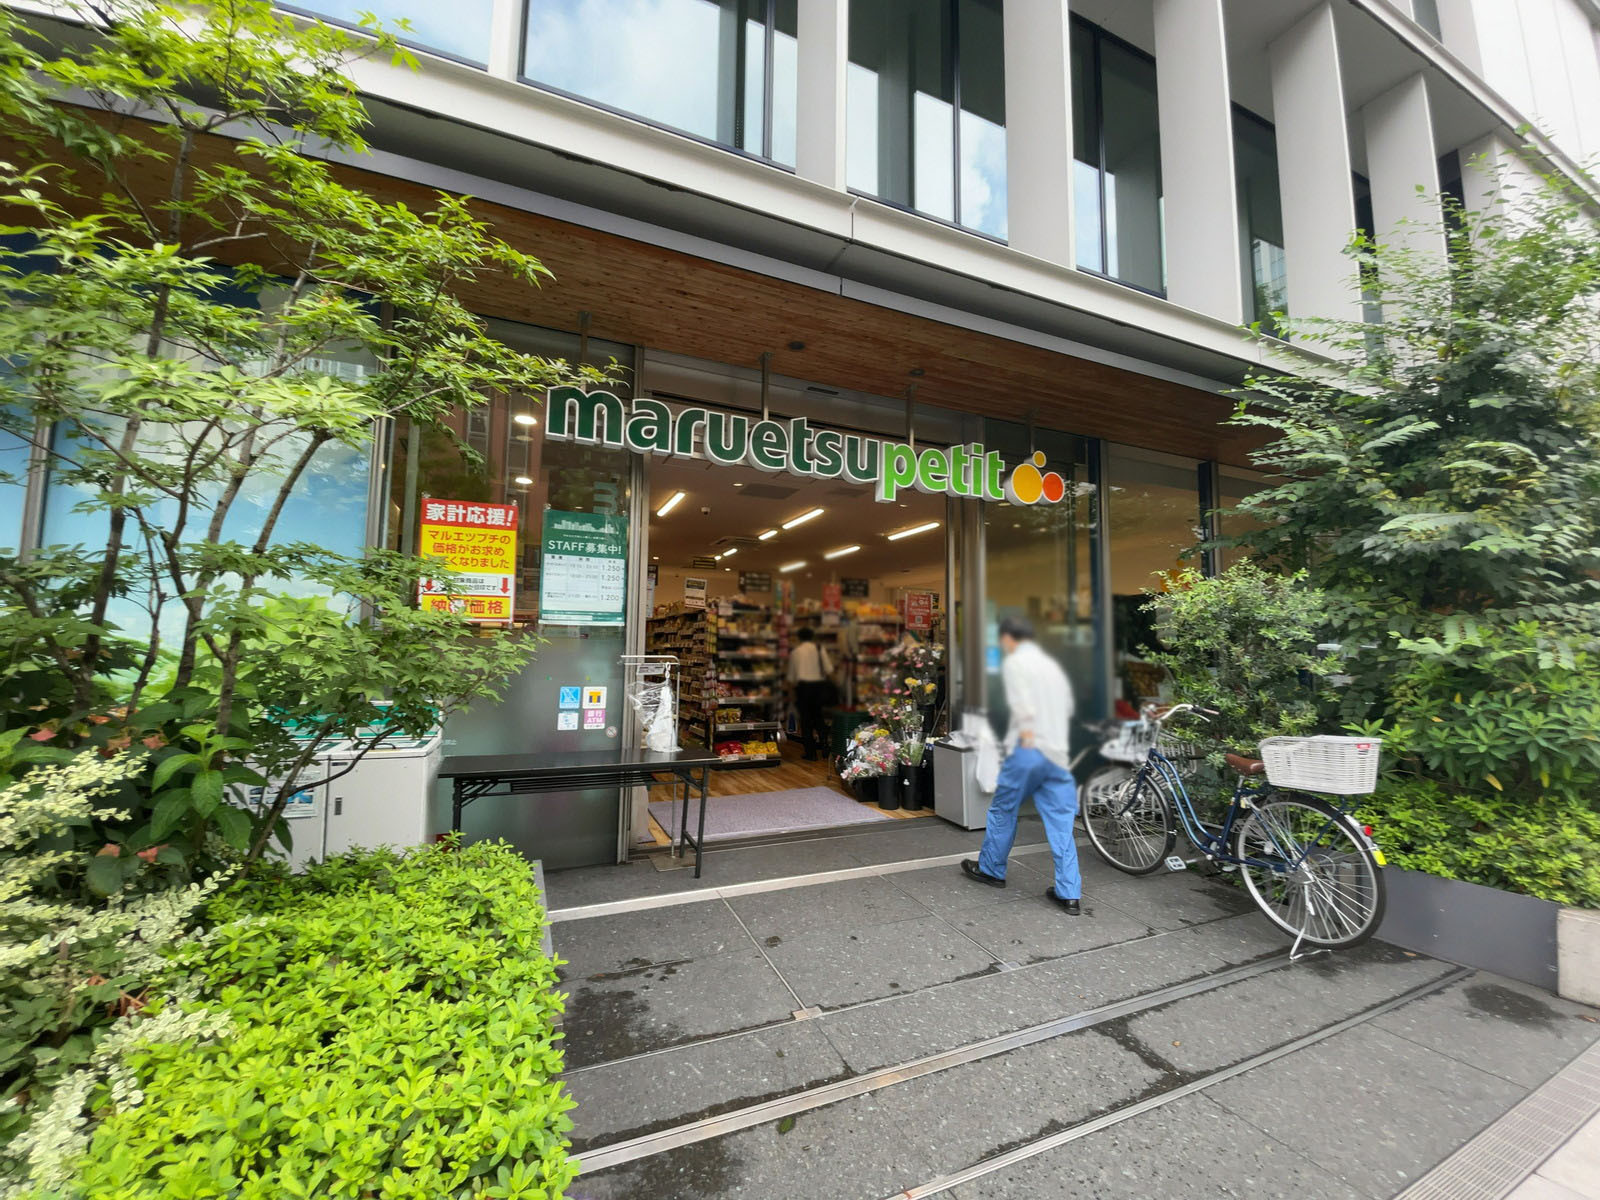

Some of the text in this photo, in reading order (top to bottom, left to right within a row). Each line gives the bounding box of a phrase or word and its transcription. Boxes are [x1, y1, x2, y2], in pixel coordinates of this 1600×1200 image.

[546, 386, 1005, 502] maruetsu petit
[425, 503, 514, 527] 家計応援!
[432, 542, 505, 557] 価格がお求め
[444, 556, 510, 569] くなりました
